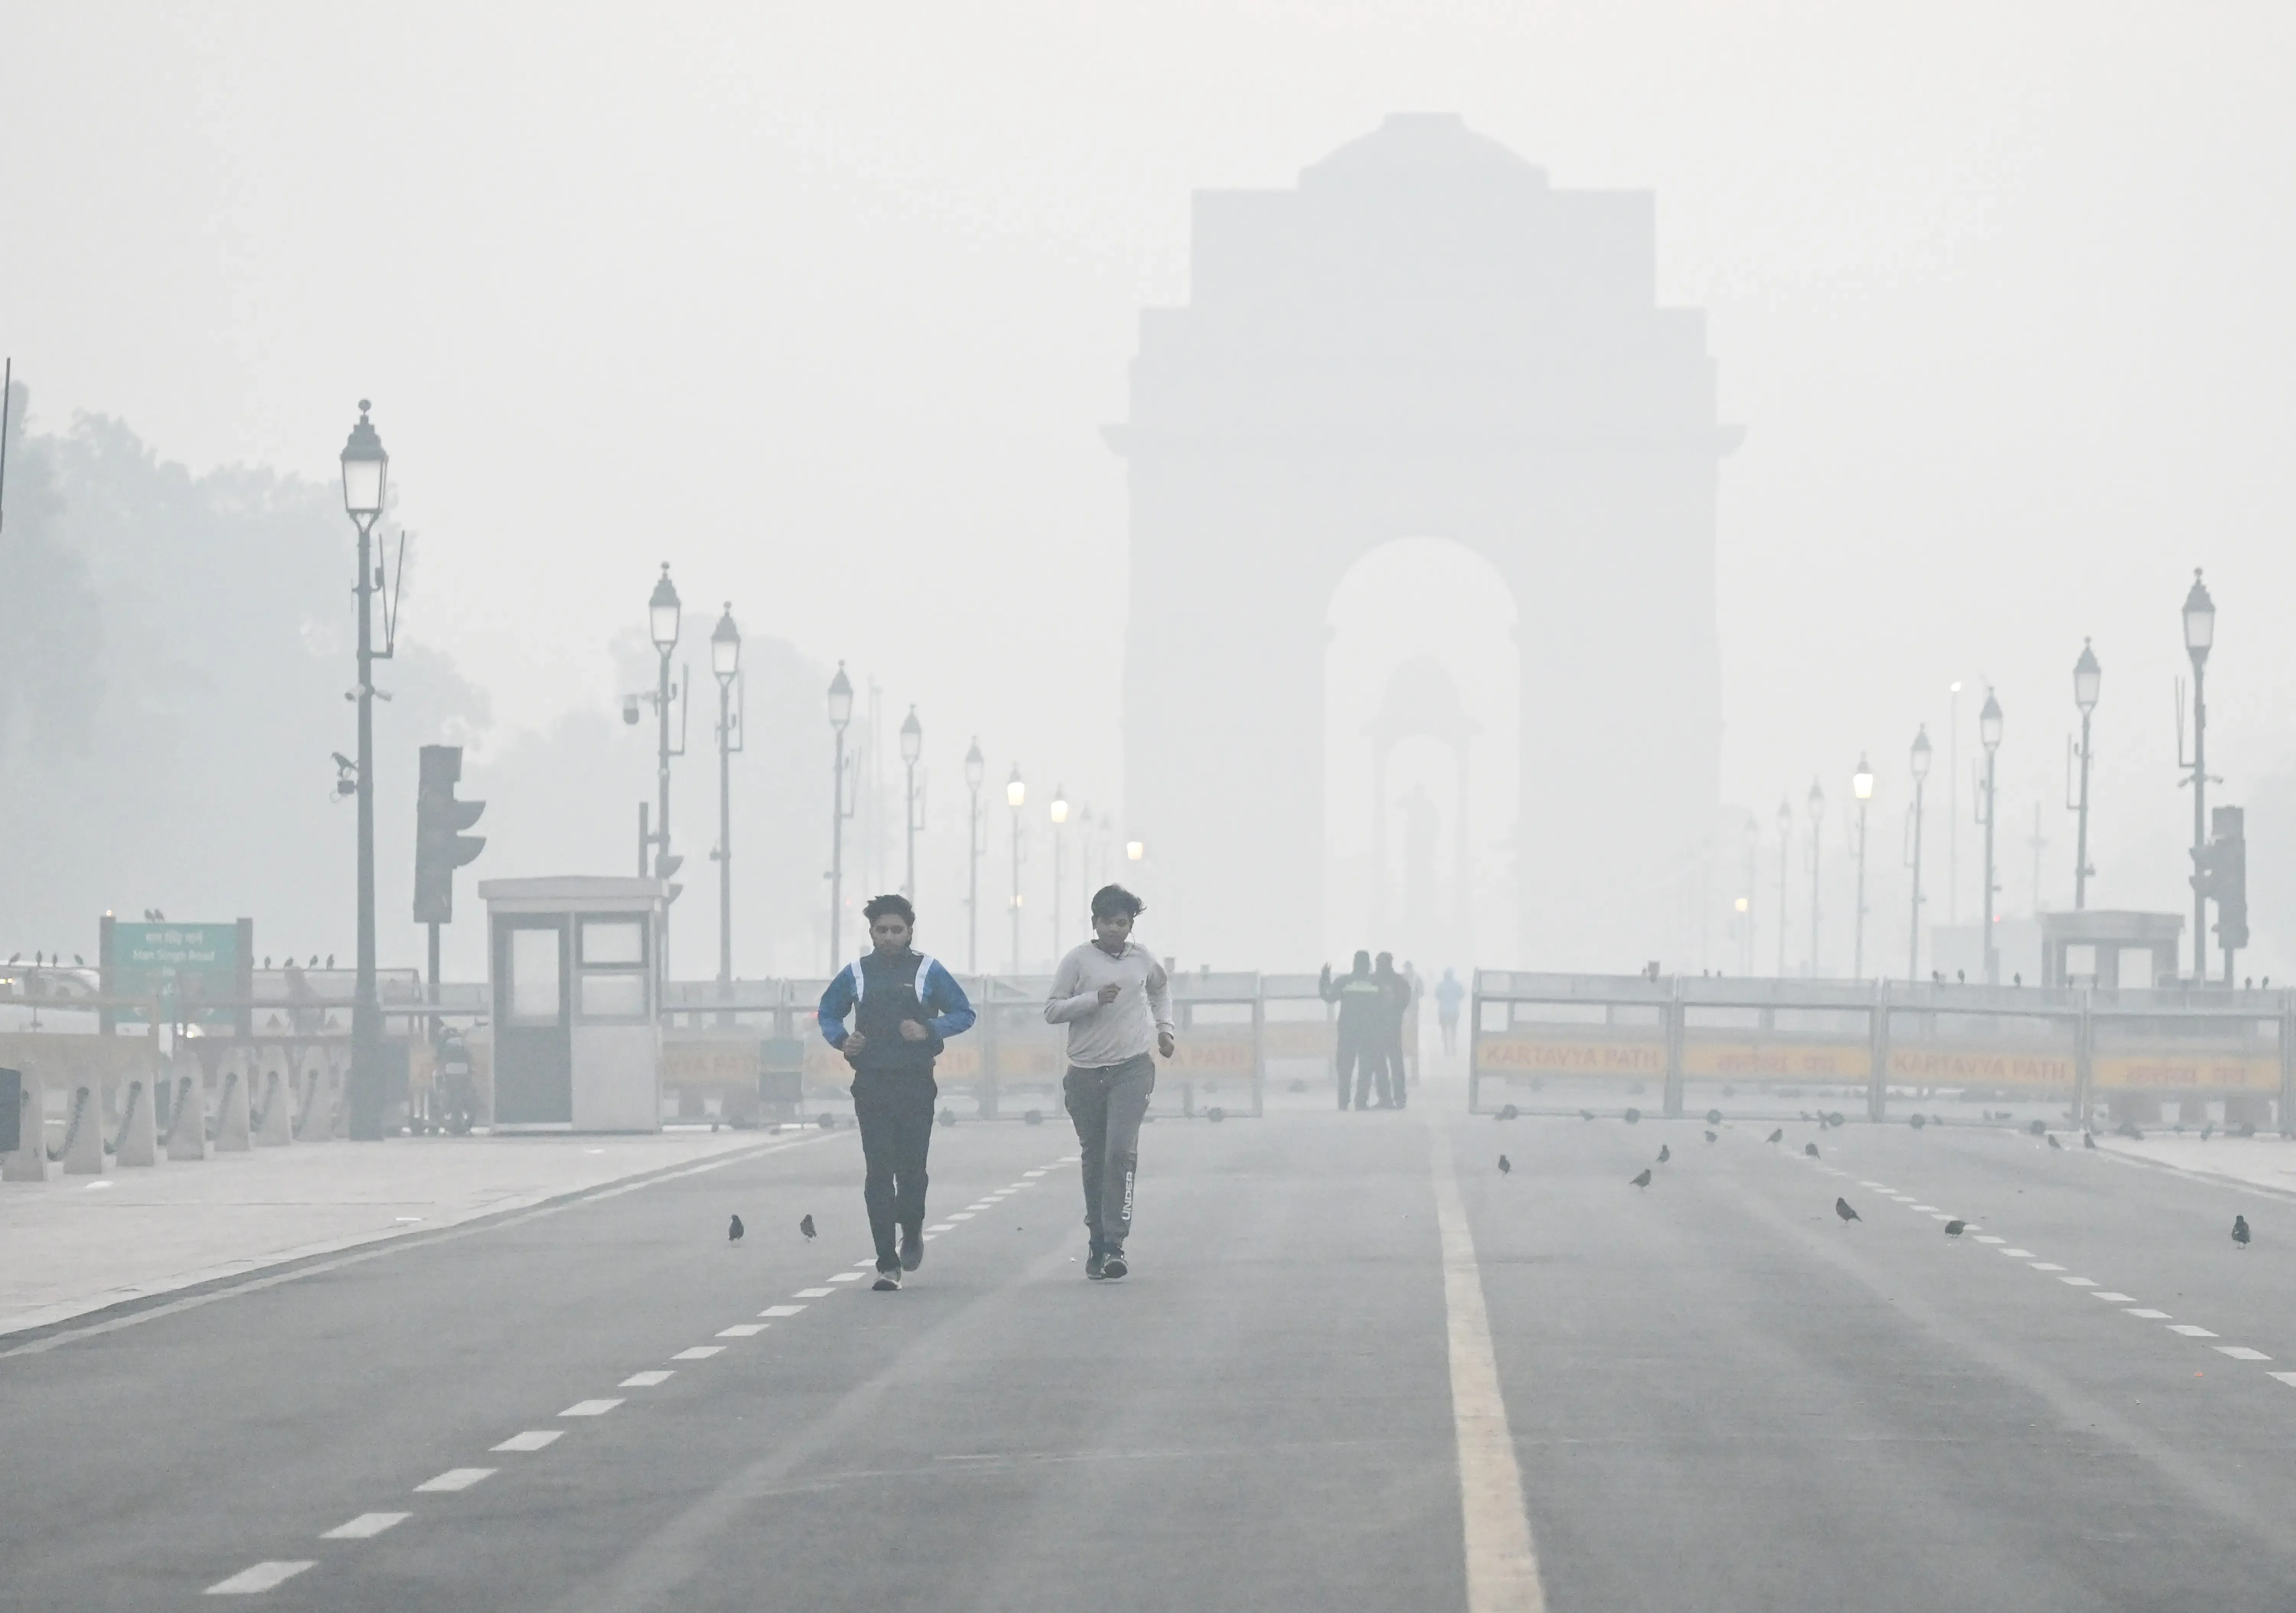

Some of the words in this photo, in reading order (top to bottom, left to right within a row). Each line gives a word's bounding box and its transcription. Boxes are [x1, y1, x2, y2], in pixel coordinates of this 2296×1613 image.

[1487, 1044, 1596, 1066] KARTAVYA
[1605, 1048, 1658, 1068] PATH
[1894, 1054, 2006, 1076] KARTAVYA
[2014, 1059, 2066, 1080] PATH
[1122, 1171, 1133, 1220] UNDER
